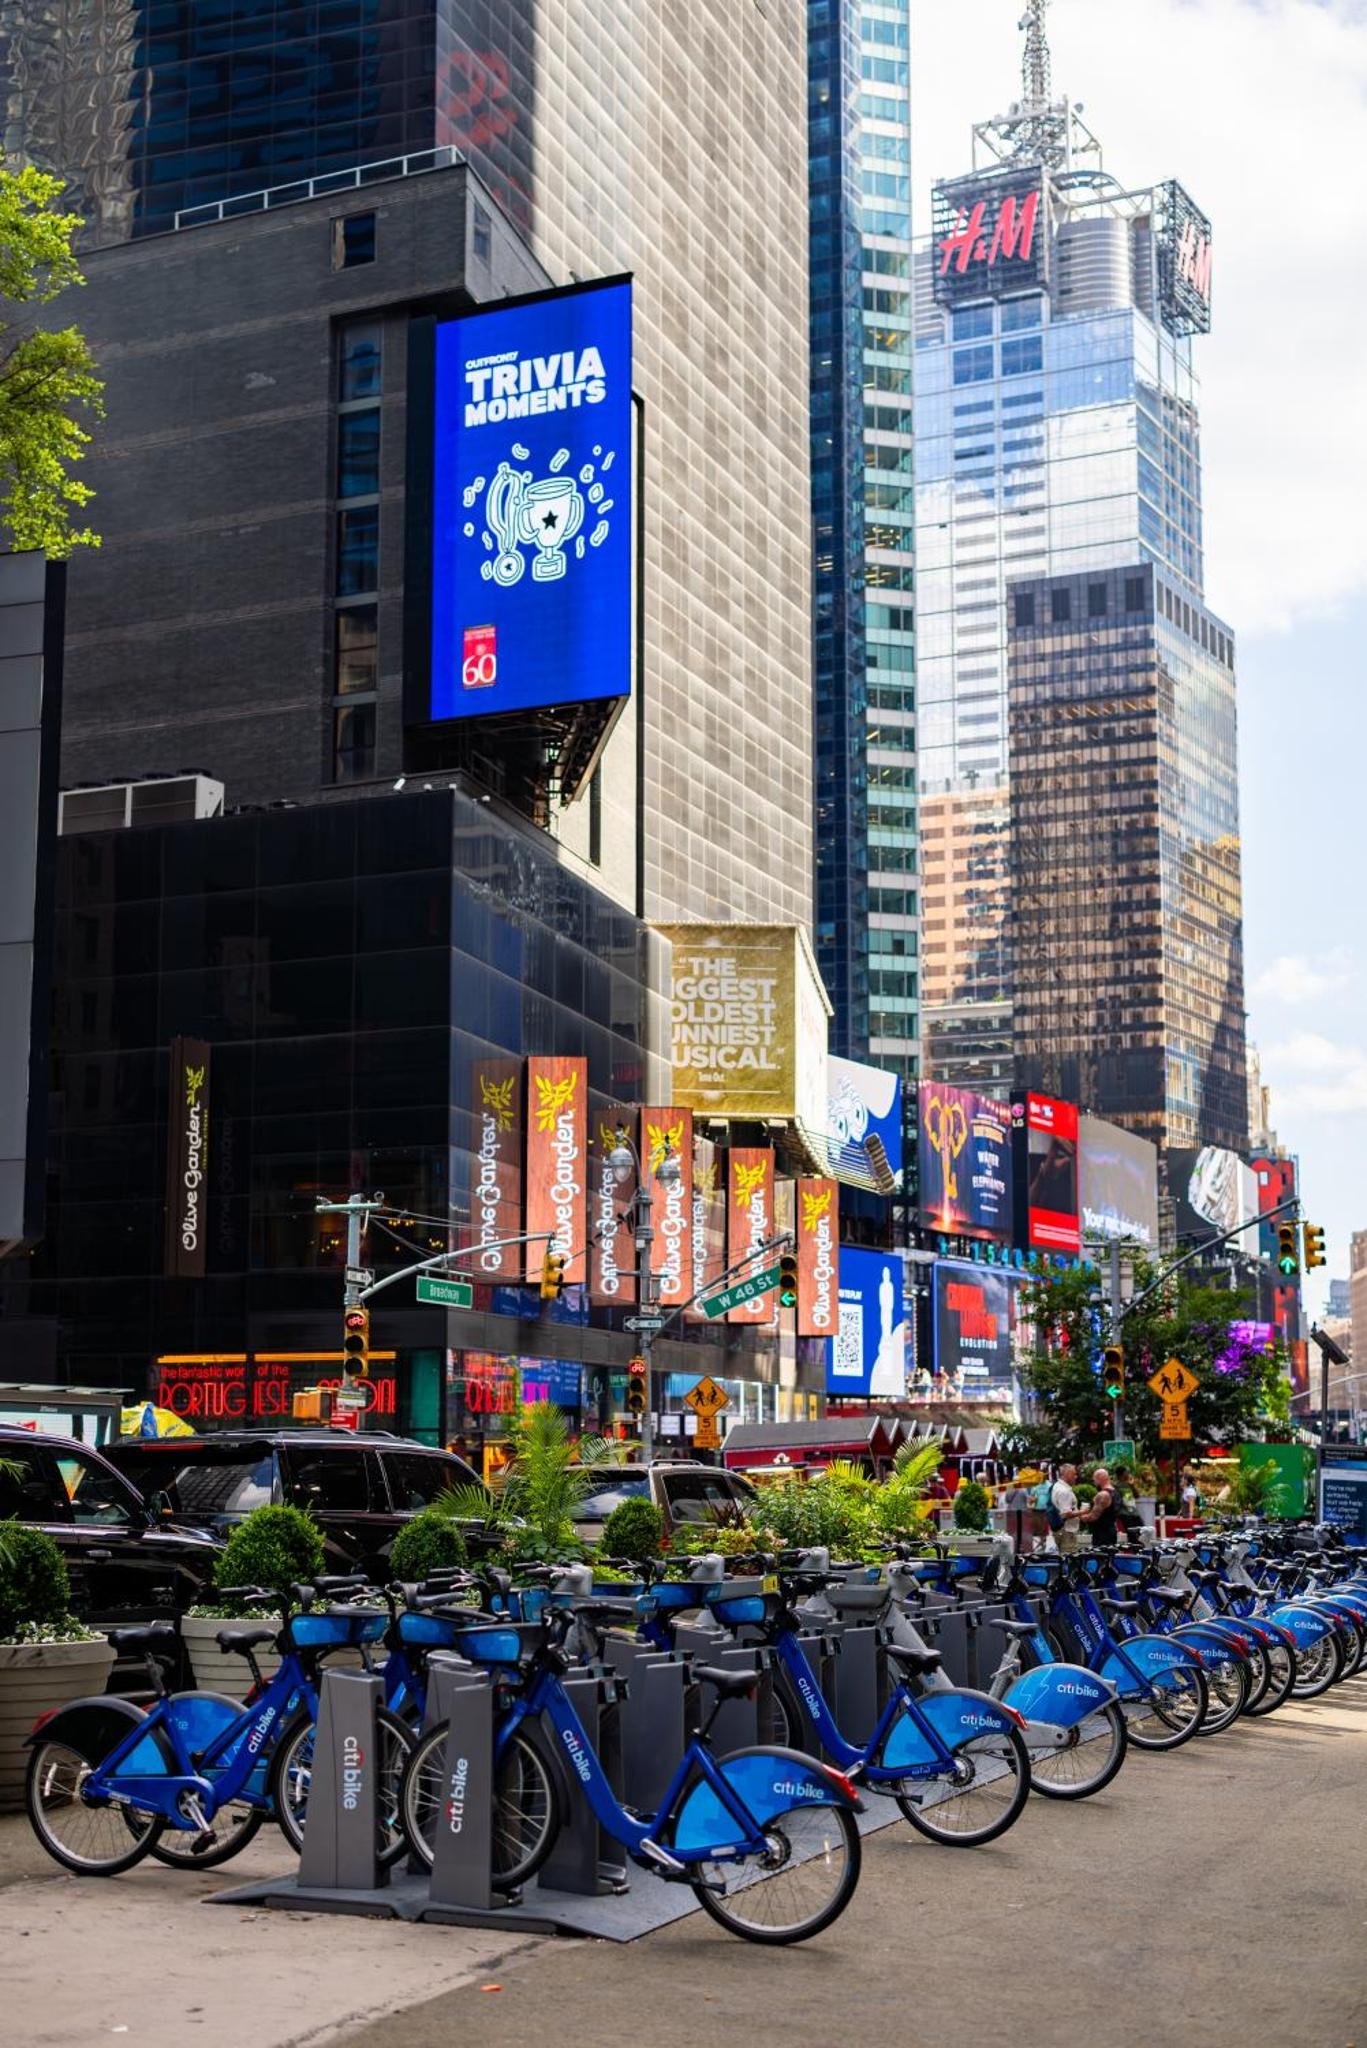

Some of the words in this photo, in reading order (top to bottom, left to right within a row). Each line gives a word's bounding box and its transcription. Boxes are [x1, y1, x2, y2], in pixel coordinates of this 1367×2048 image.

[938, 190, 1040, 276] H&M
[464, 346, 606, 403] TRIVIA
[464, 379, 607, 428] MOMENTS
[463, 653, 497, 686] 60
[671, 1024, 777, 1046] UNNIEST
[1012, 1118, 1024, 1128] LG
[184, 1101, 202, 1188] Garden
[550, 1109, 580, 1204] Garden
[183, 1190, 198, 1251] Olive
[660, 1236, 681, 1294] Olive
[813, 1215, 835, 1281] Garden
[429, 1284, 460, 1304] Broadway
[718, 1294, 731, 1309] W
[735, 1284, 755, 1300] 48
[758, 1273, 775, 1291] St
[811, 1282, 830, 1328] Olive
[160, 1366, 176, 1378] the
[178, 1365, 222, 1379] fantastic
[257, 1364, 268, 1377] of
[271, 1364, 289, 1377] the
[702, 1417, 711, 1428] 5
[1170, 1404, 1180, 1417] 5
[798, 1677, 812, 1697] citi
[806, 1694, 821, 1719] bike
[1057, 1683, 1075, 1694] citi
[1076, 1684, 1099, 1698] bike
[248, 1731, 264, 1754] citi
[256, 1706, 276, 1734] bike
[960, 1714, 978, 1726] citi
[978, 1715, 1002, 1728] bike
[343, 1736, 361, 1767] citi
[562, 1730, 580, 1753] citi
[572, 1751, 592, 1782] bike
[343, 1769, 362, 1810] bike
[450, 1757, 468, 1799] bike
[773, 1781, 795, 1795] citi
[796, 1783, 825, 1799] bike
[450, 1802, 465, 1834] citi
